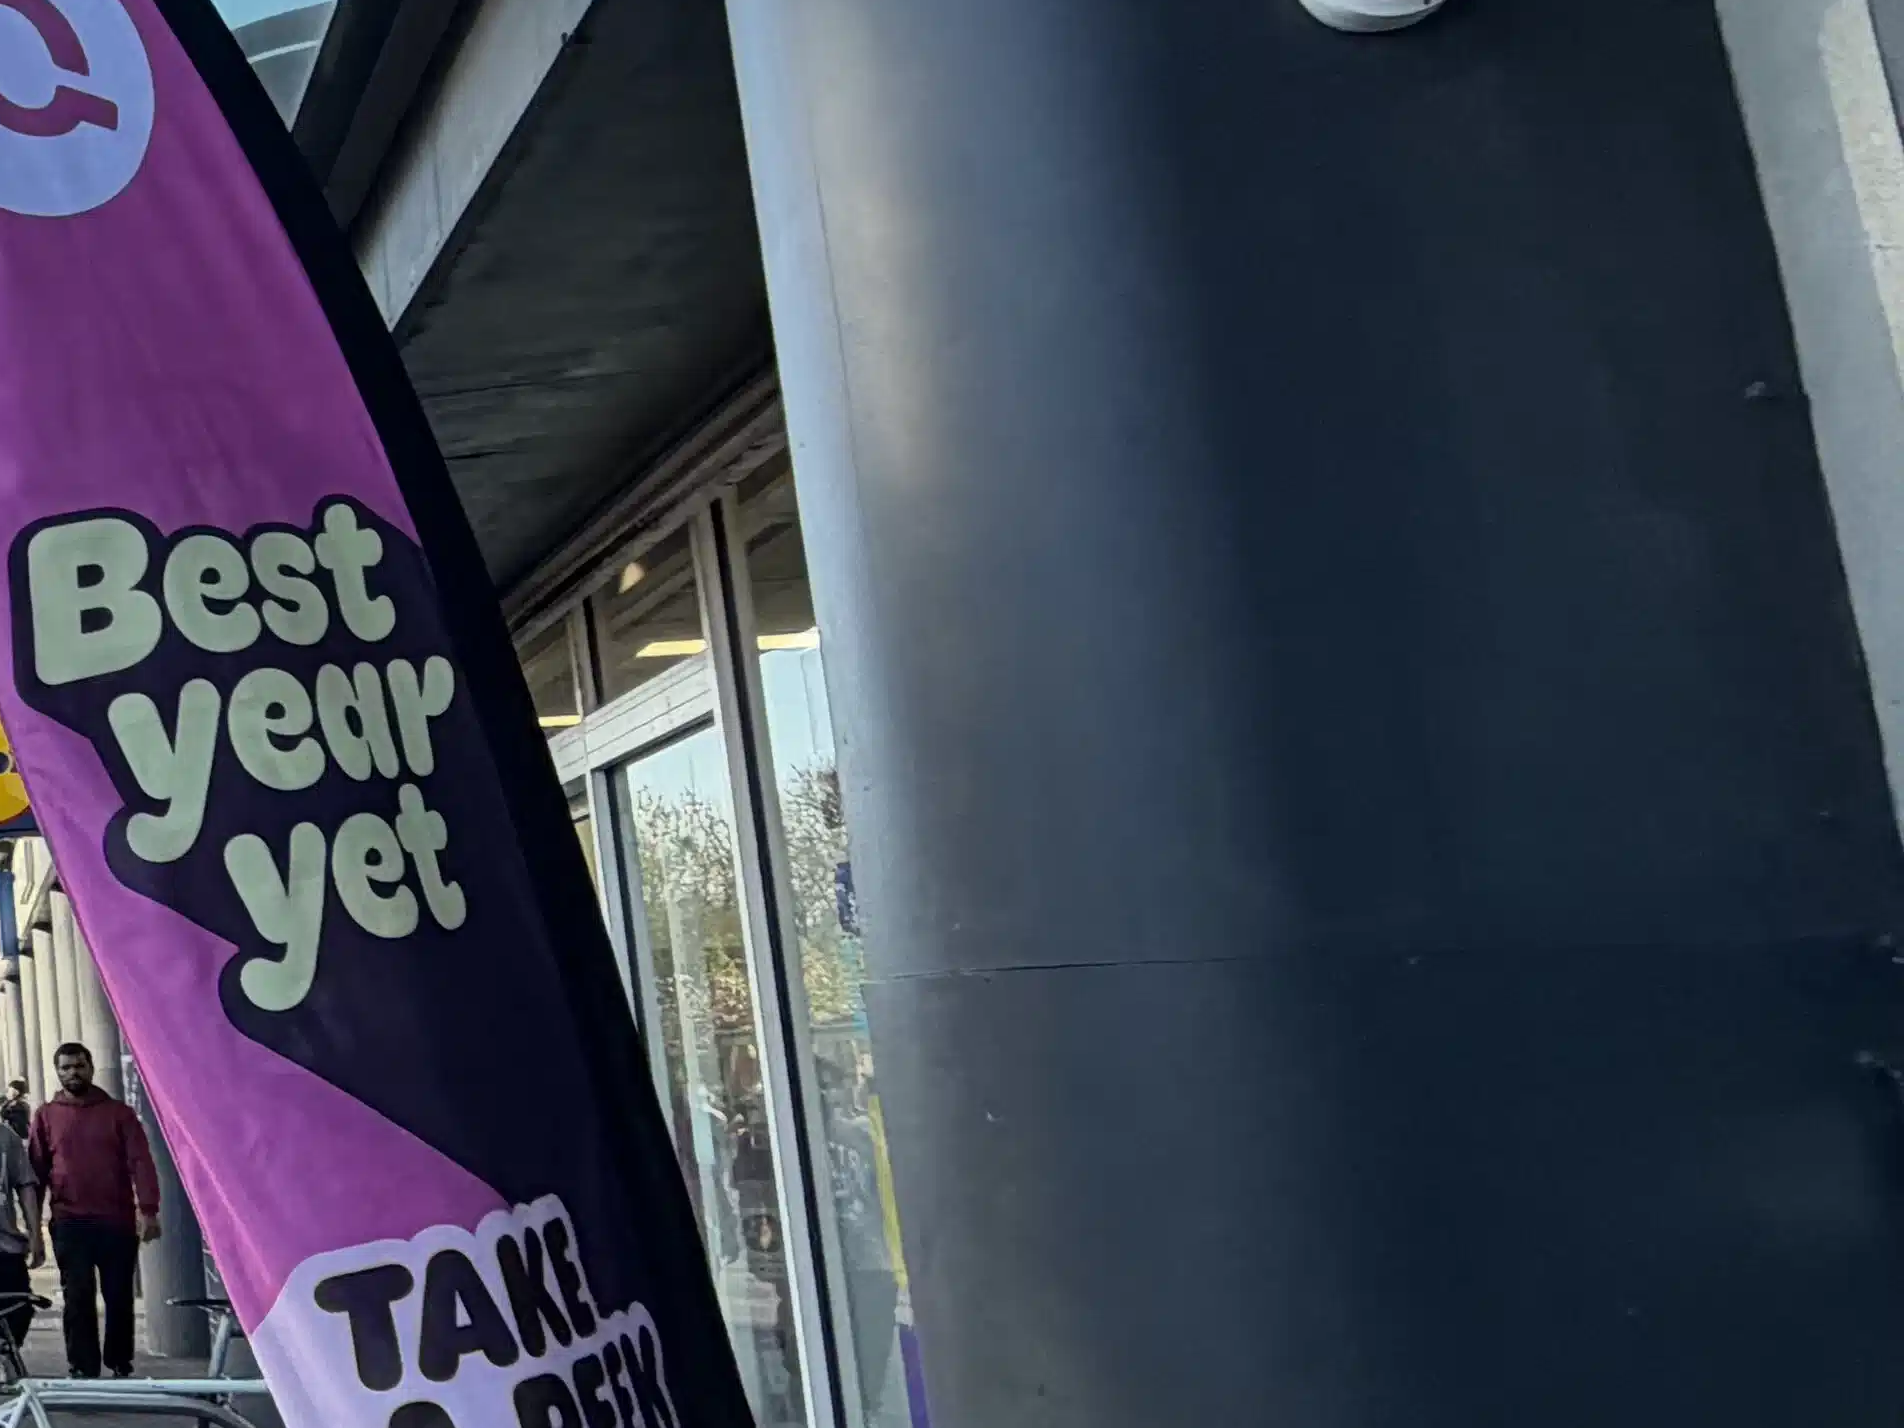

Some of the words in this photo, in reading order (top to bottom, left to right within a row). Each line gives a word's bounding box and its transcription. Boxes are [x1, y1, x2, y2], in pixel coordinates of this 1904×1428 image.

[27, 502, 395, 686] Best
[107, 654, 455, 863] year
[223, 783, 467, 1012] yet
[313, 1217, 597, 1392] TAKE
